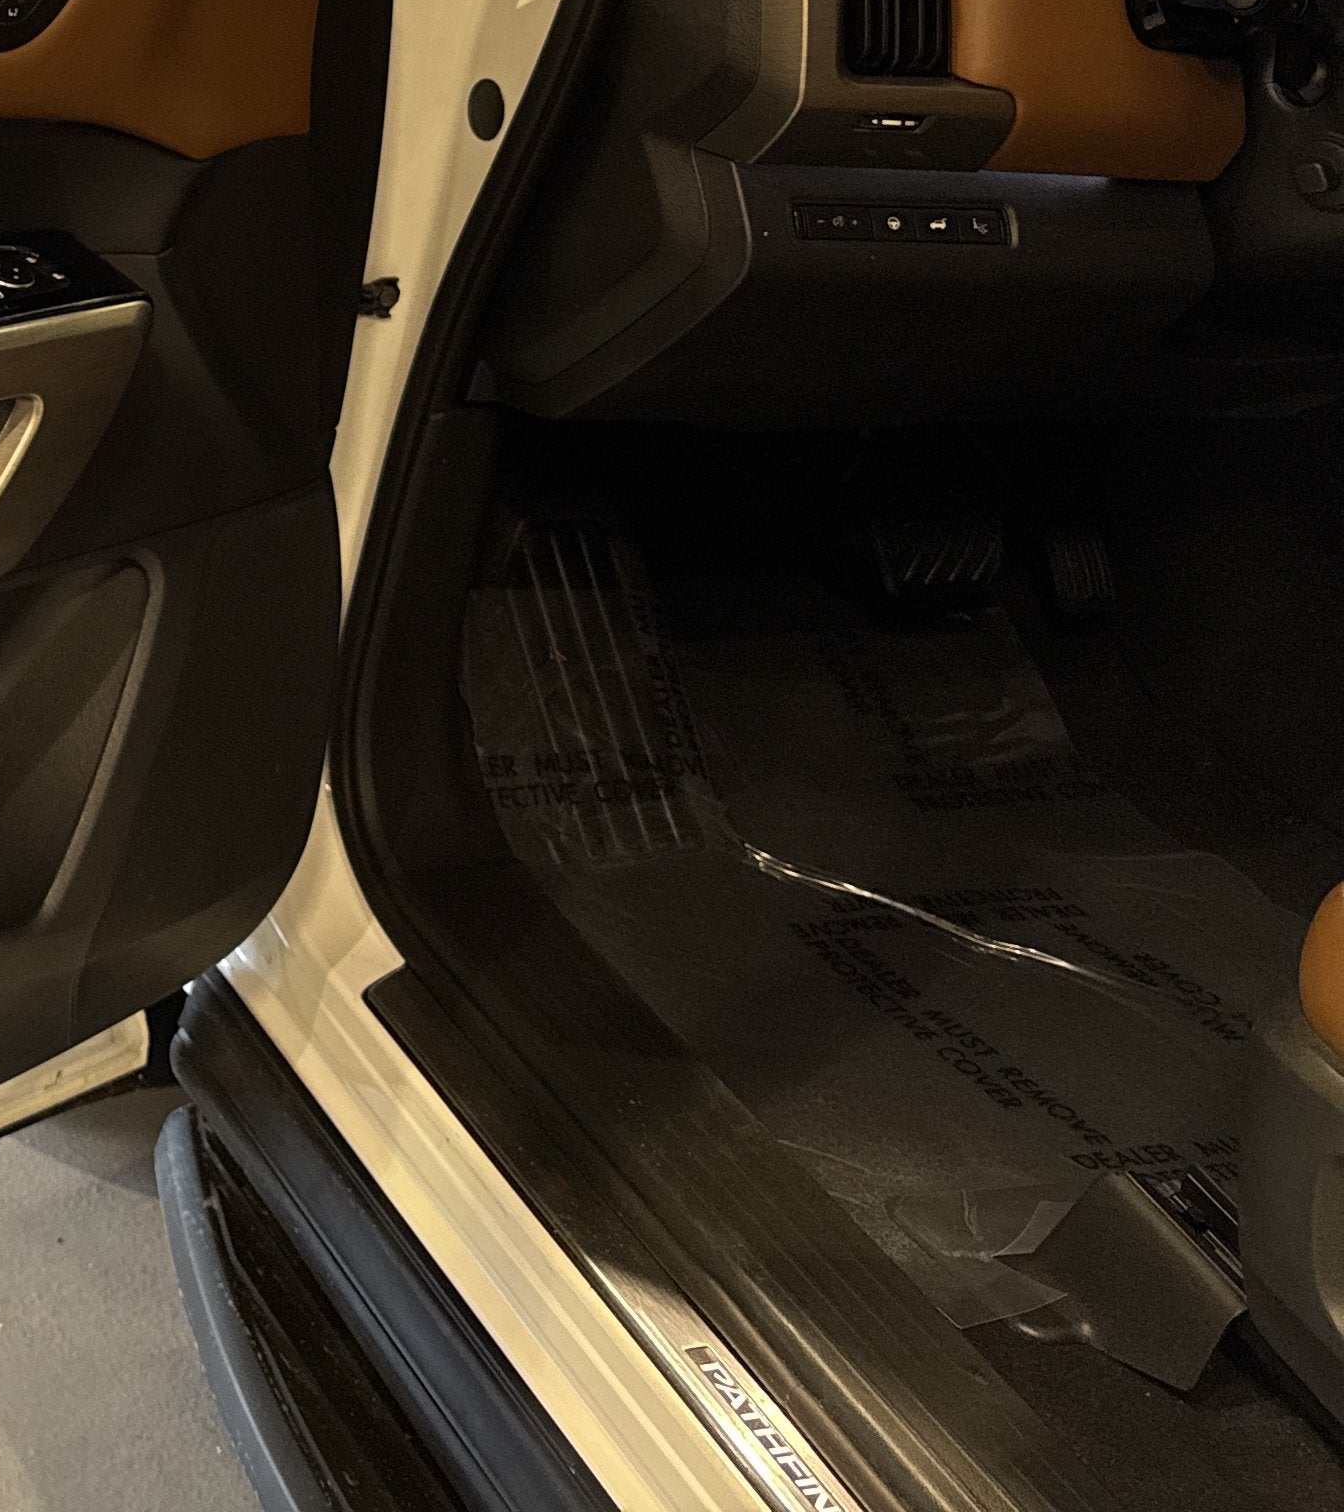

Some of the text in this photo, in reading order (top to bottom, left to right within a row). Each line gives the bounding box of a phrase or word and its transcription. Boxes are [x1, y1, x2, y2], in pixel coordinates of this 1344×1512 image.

[921, 1009, 1000, 1057] MUST
[997, 1066, 1113, 1146] REMOVE
[936, 1046, 1024, 1108] COVER
[1069, 1143, 1184, 1172] DEALER
